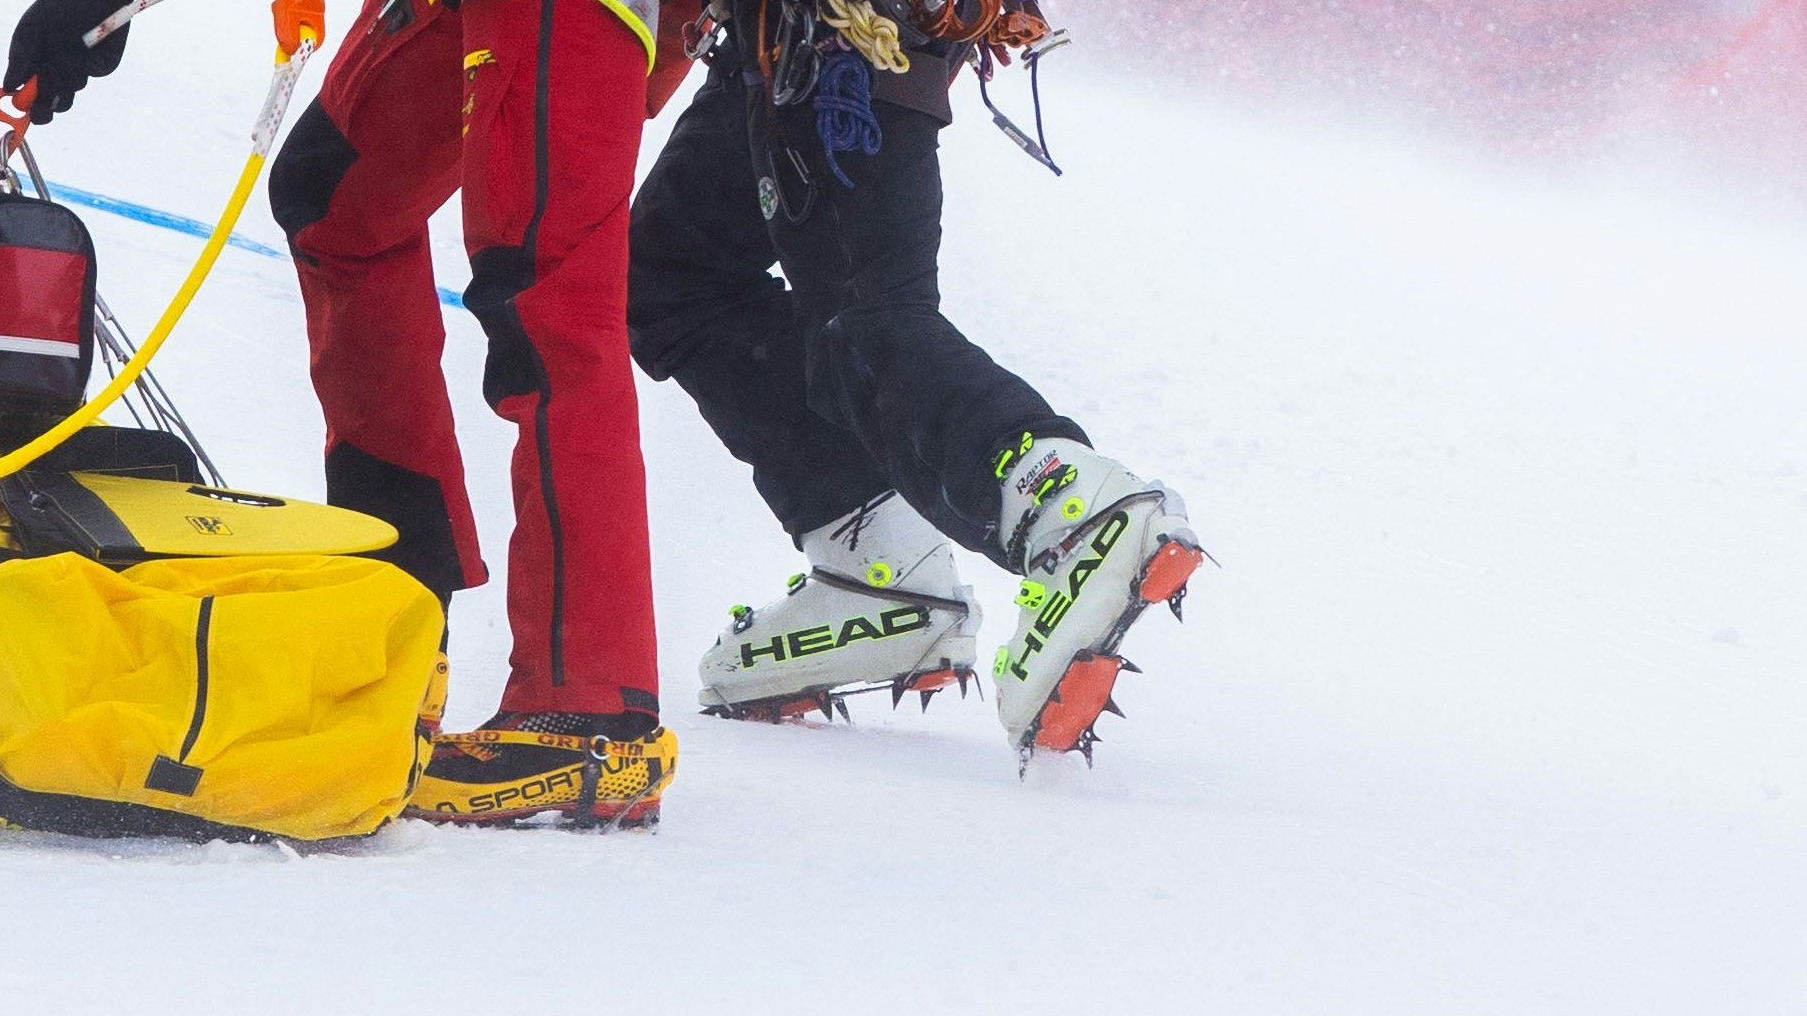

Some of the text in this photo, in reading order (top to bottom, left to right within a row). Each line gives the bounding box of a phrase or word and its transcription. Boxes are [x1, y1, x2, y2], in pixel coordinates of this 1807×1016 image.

[1015, 448, 1058, 496] RAPTOR
[1009, 510, 1131, 683] HEAD
[740, 604, 931, 669] HEAD
